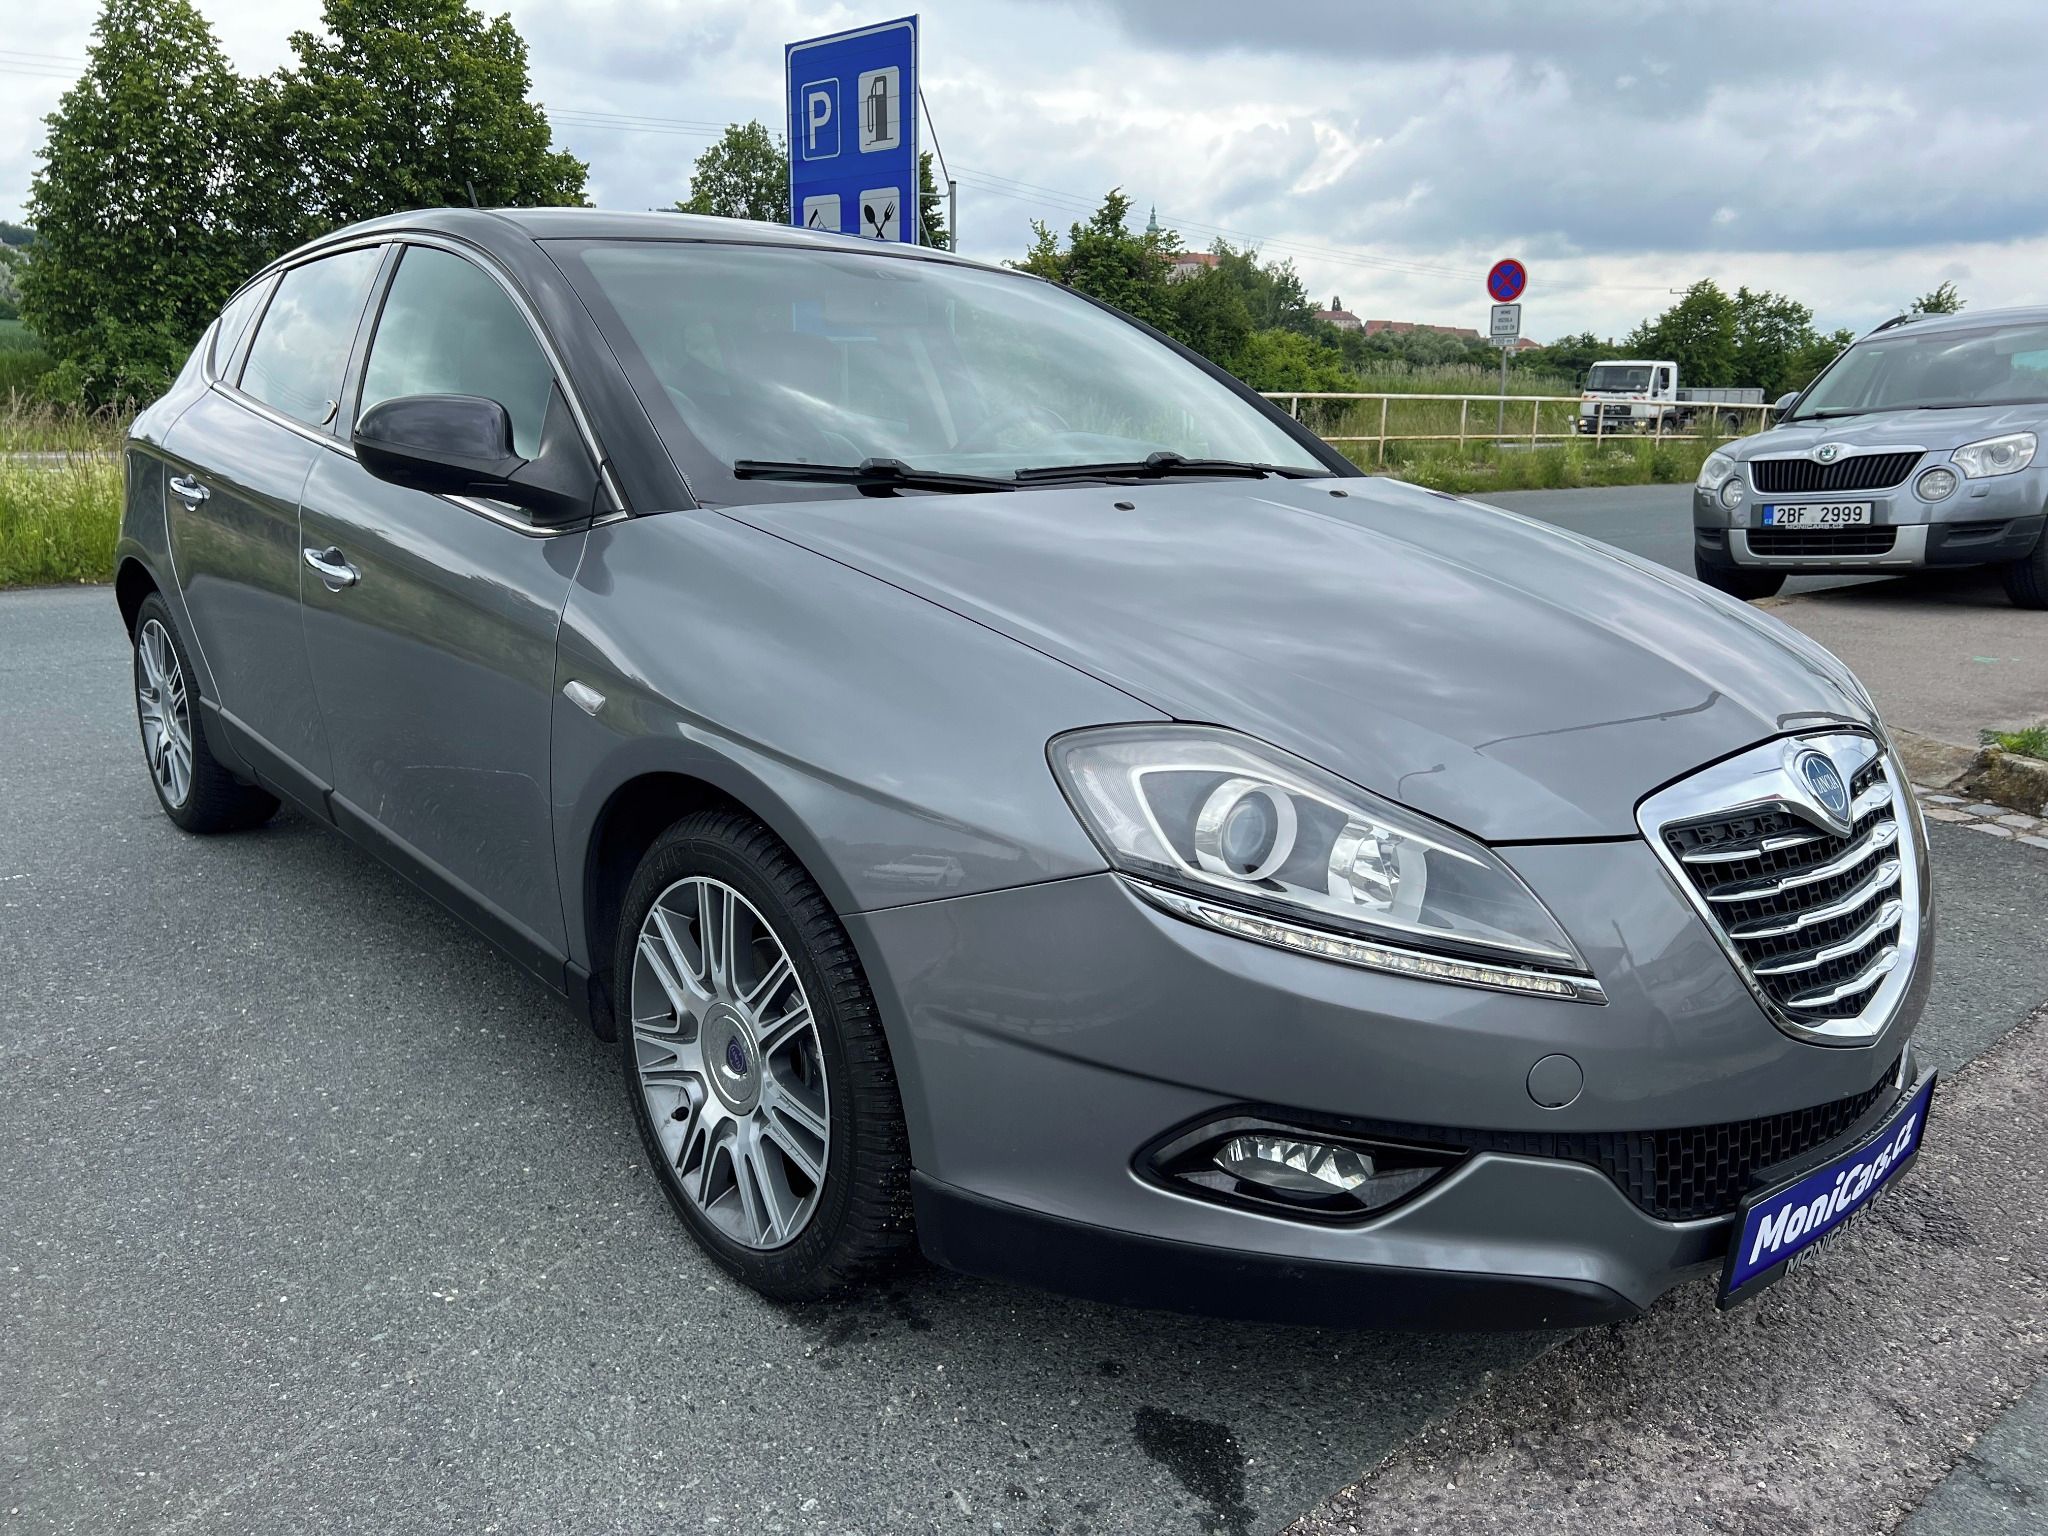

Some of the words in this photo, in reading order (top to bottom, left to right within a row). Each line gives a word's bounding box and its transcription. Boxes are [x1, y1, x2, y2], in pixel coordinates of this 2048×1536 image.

[808, 91, 832, 150] P
[1777, 507, 1807, 523] 2BF
[1820, 506, 1863, 522] 2999
[1812, 773, 1839, 793] LANCIA
